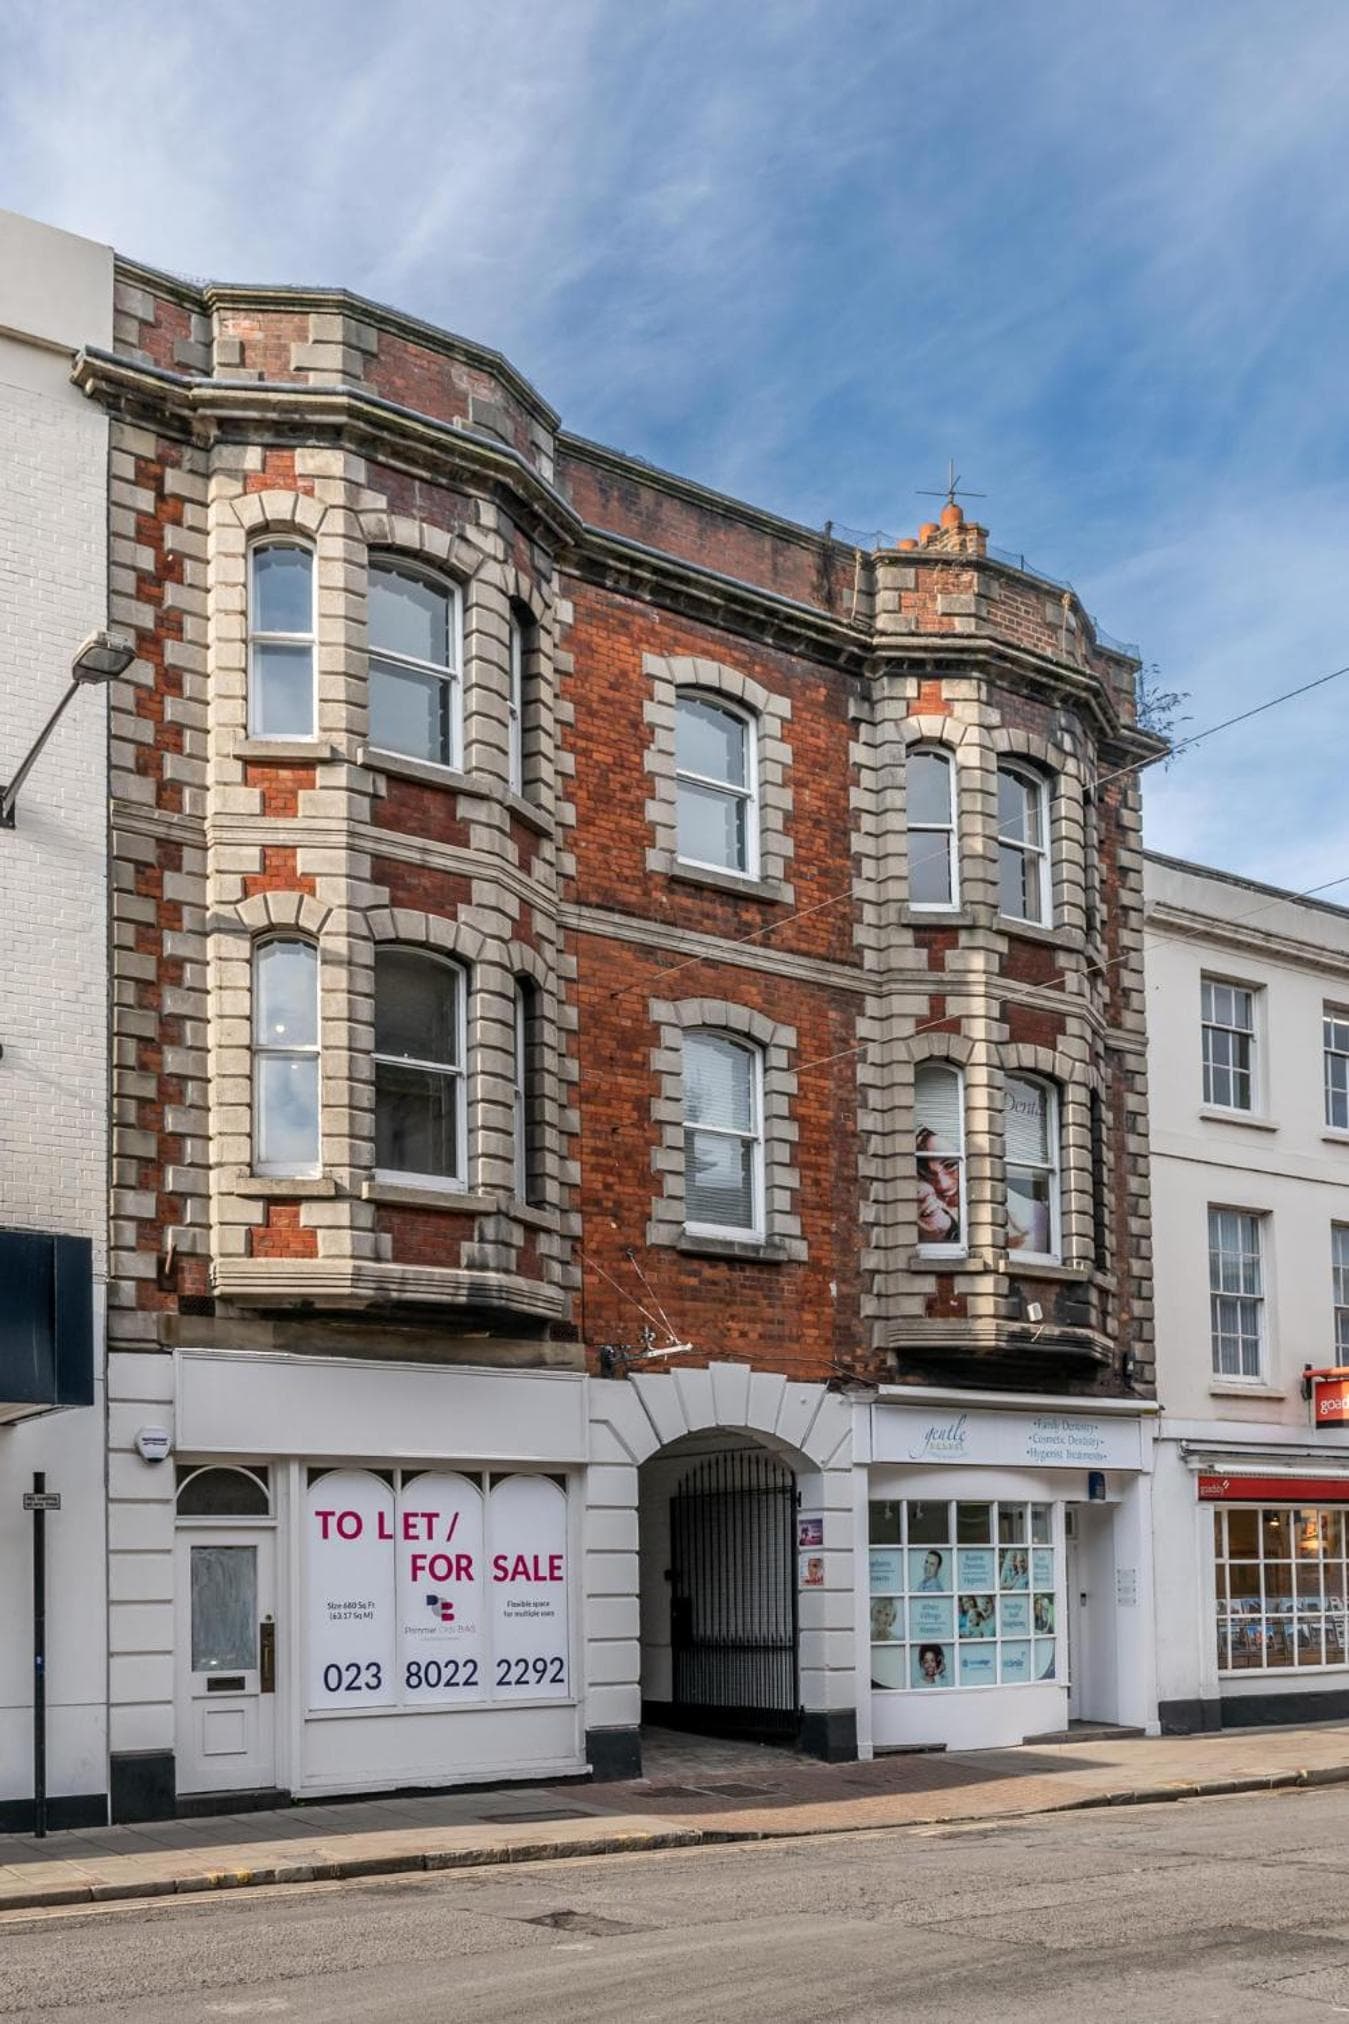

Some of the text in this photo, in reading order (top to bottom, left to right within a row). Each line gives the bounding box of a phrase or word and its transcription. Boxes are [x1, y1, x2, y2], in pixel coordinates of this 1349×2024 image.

[909, 1413, 967, 1459] gentle
[1032, 1434, 1066, 1445] Cosmetic
[315, 1511, 363, 1540] TO
[411, 1554, 564, 1582] FOR SALE
[324, 1657, 565, 1692] 023 8022 2292
